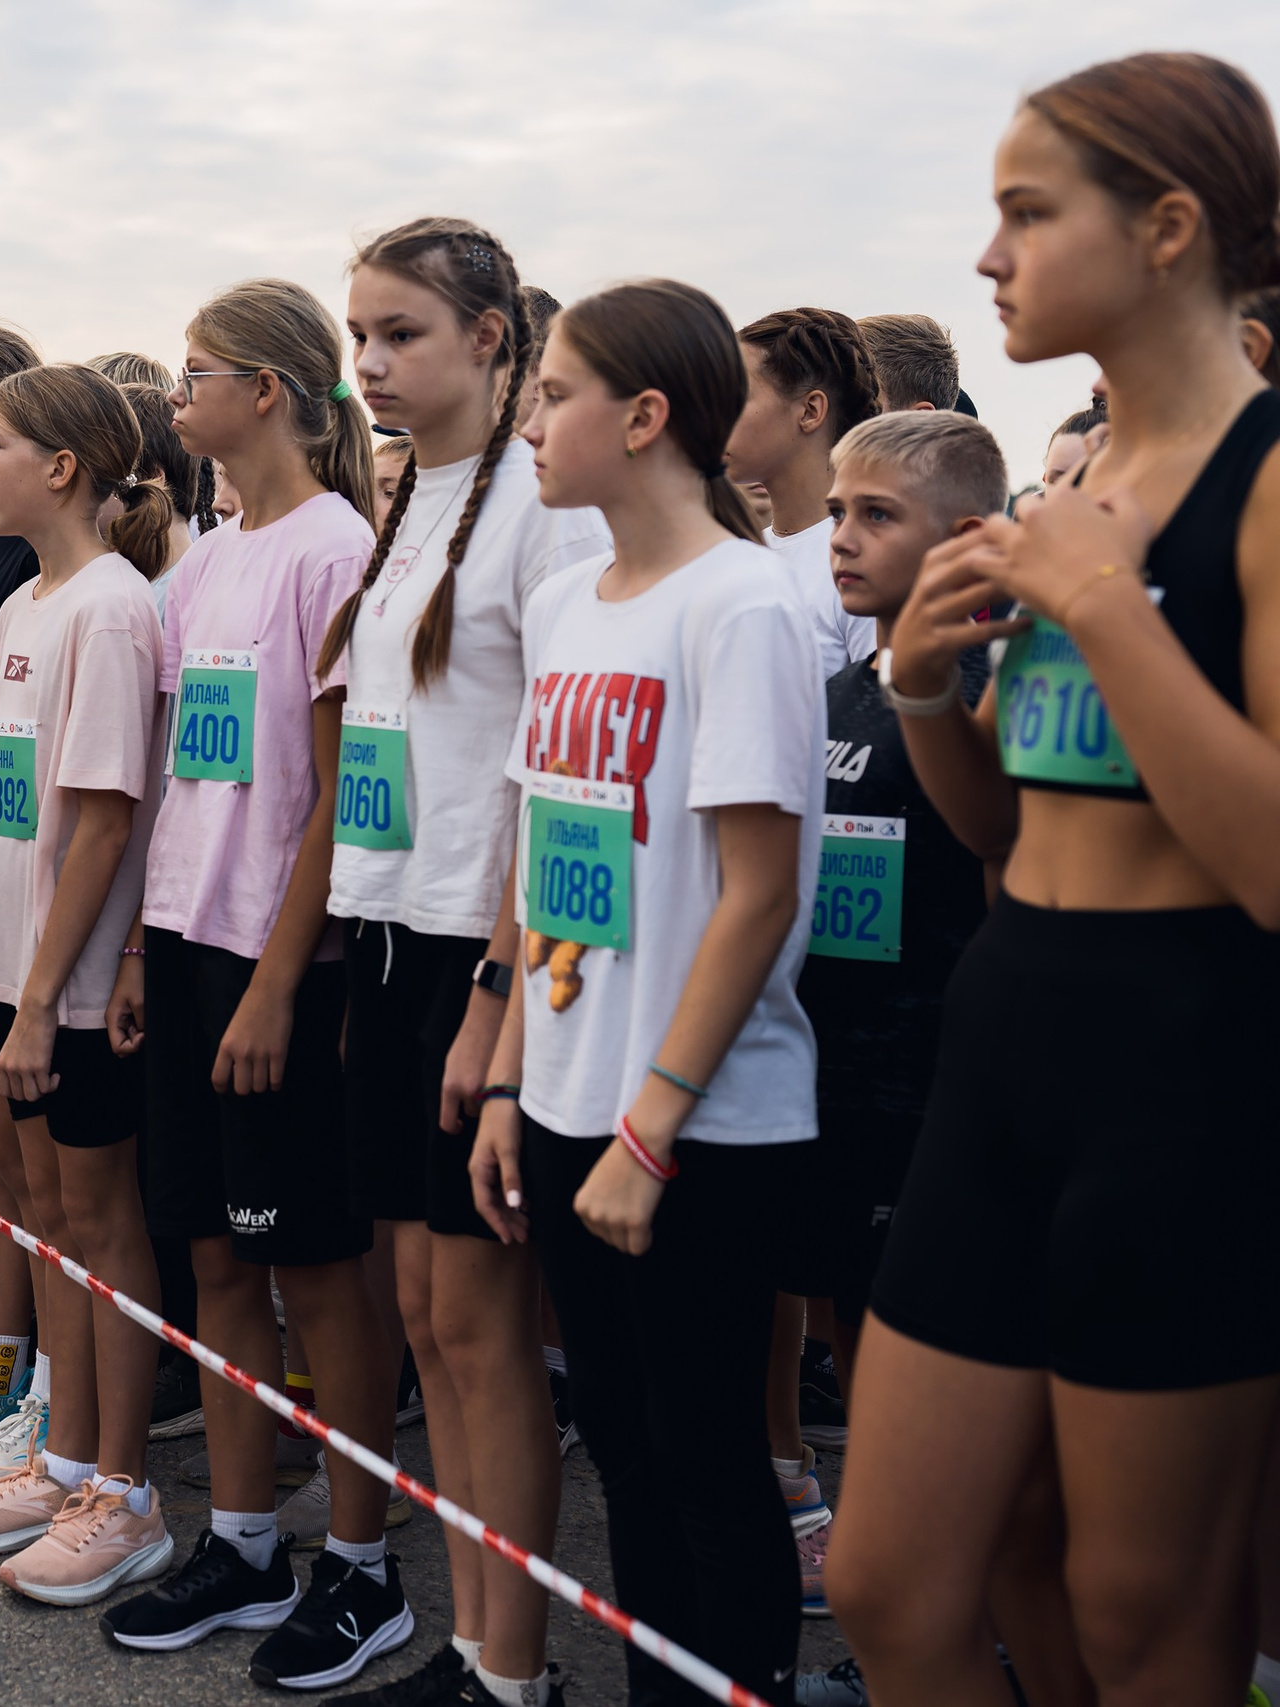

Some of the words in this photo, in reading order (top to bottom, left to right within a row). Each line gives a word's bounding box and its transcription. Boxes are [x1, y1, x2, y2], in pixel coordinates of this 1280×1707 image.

[180, 712, 240, 764] 400
[342, 741, 377, 766] СОФИЯ
[856, 823, 874, 834] Пэй
[539, 853, 613, 925] 1088
